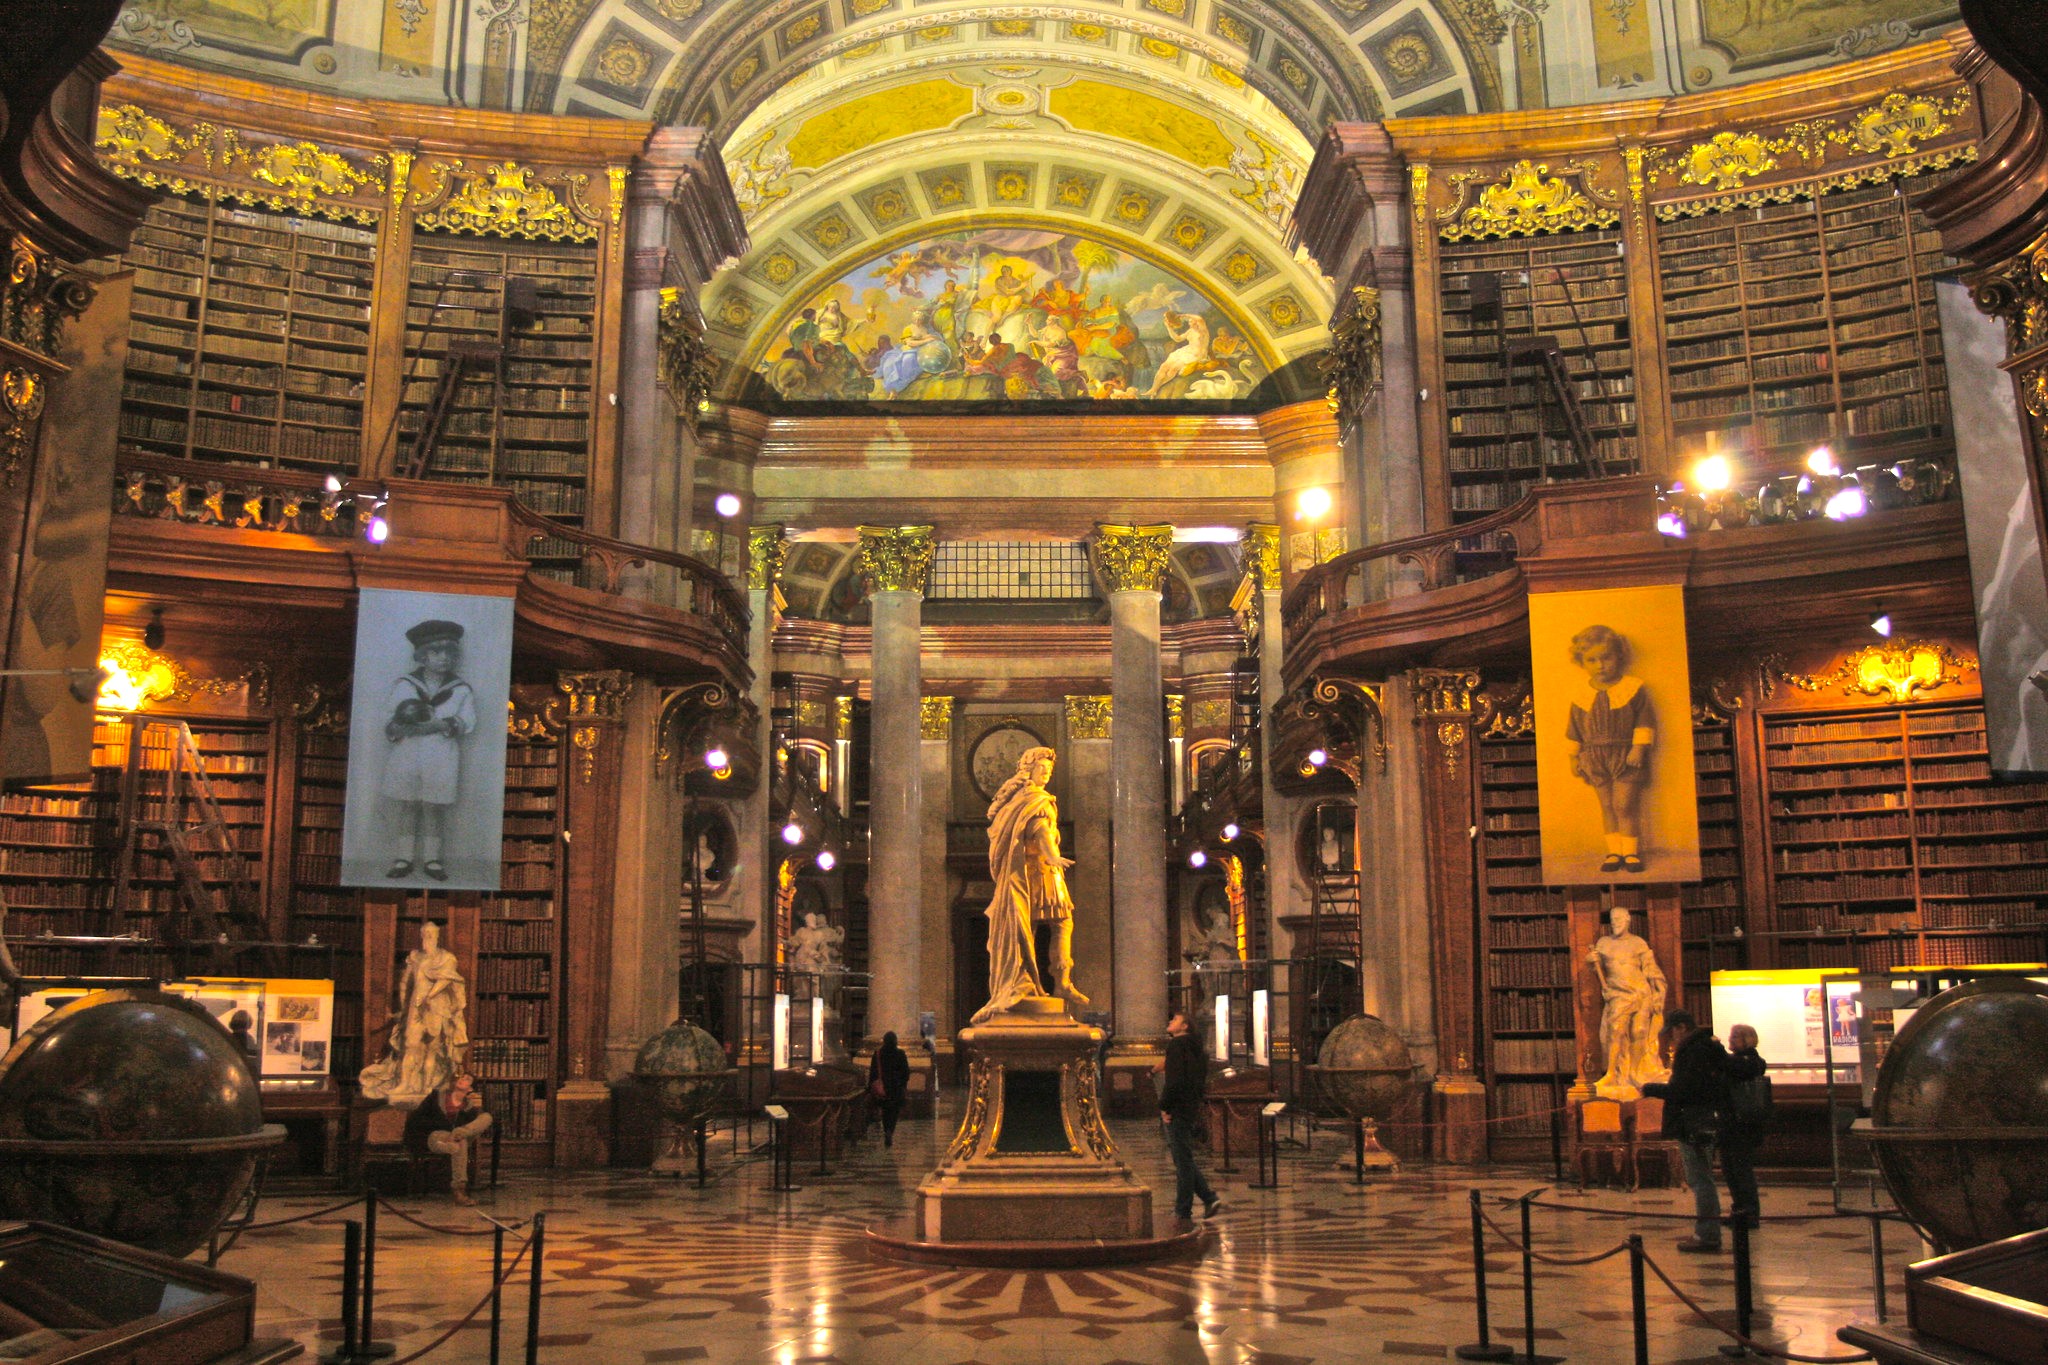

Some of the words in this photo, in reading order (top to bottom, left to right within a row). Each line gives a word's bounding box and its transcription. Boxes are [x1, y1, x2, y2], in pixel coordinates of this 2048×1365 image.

[1871, 116, 1926, 137] XXXVIII
[1709, 154, 1750, 169] XXXIX
[1516, 190, 1536, 201] XL
[1883, 662, 1912, 679] VIII
